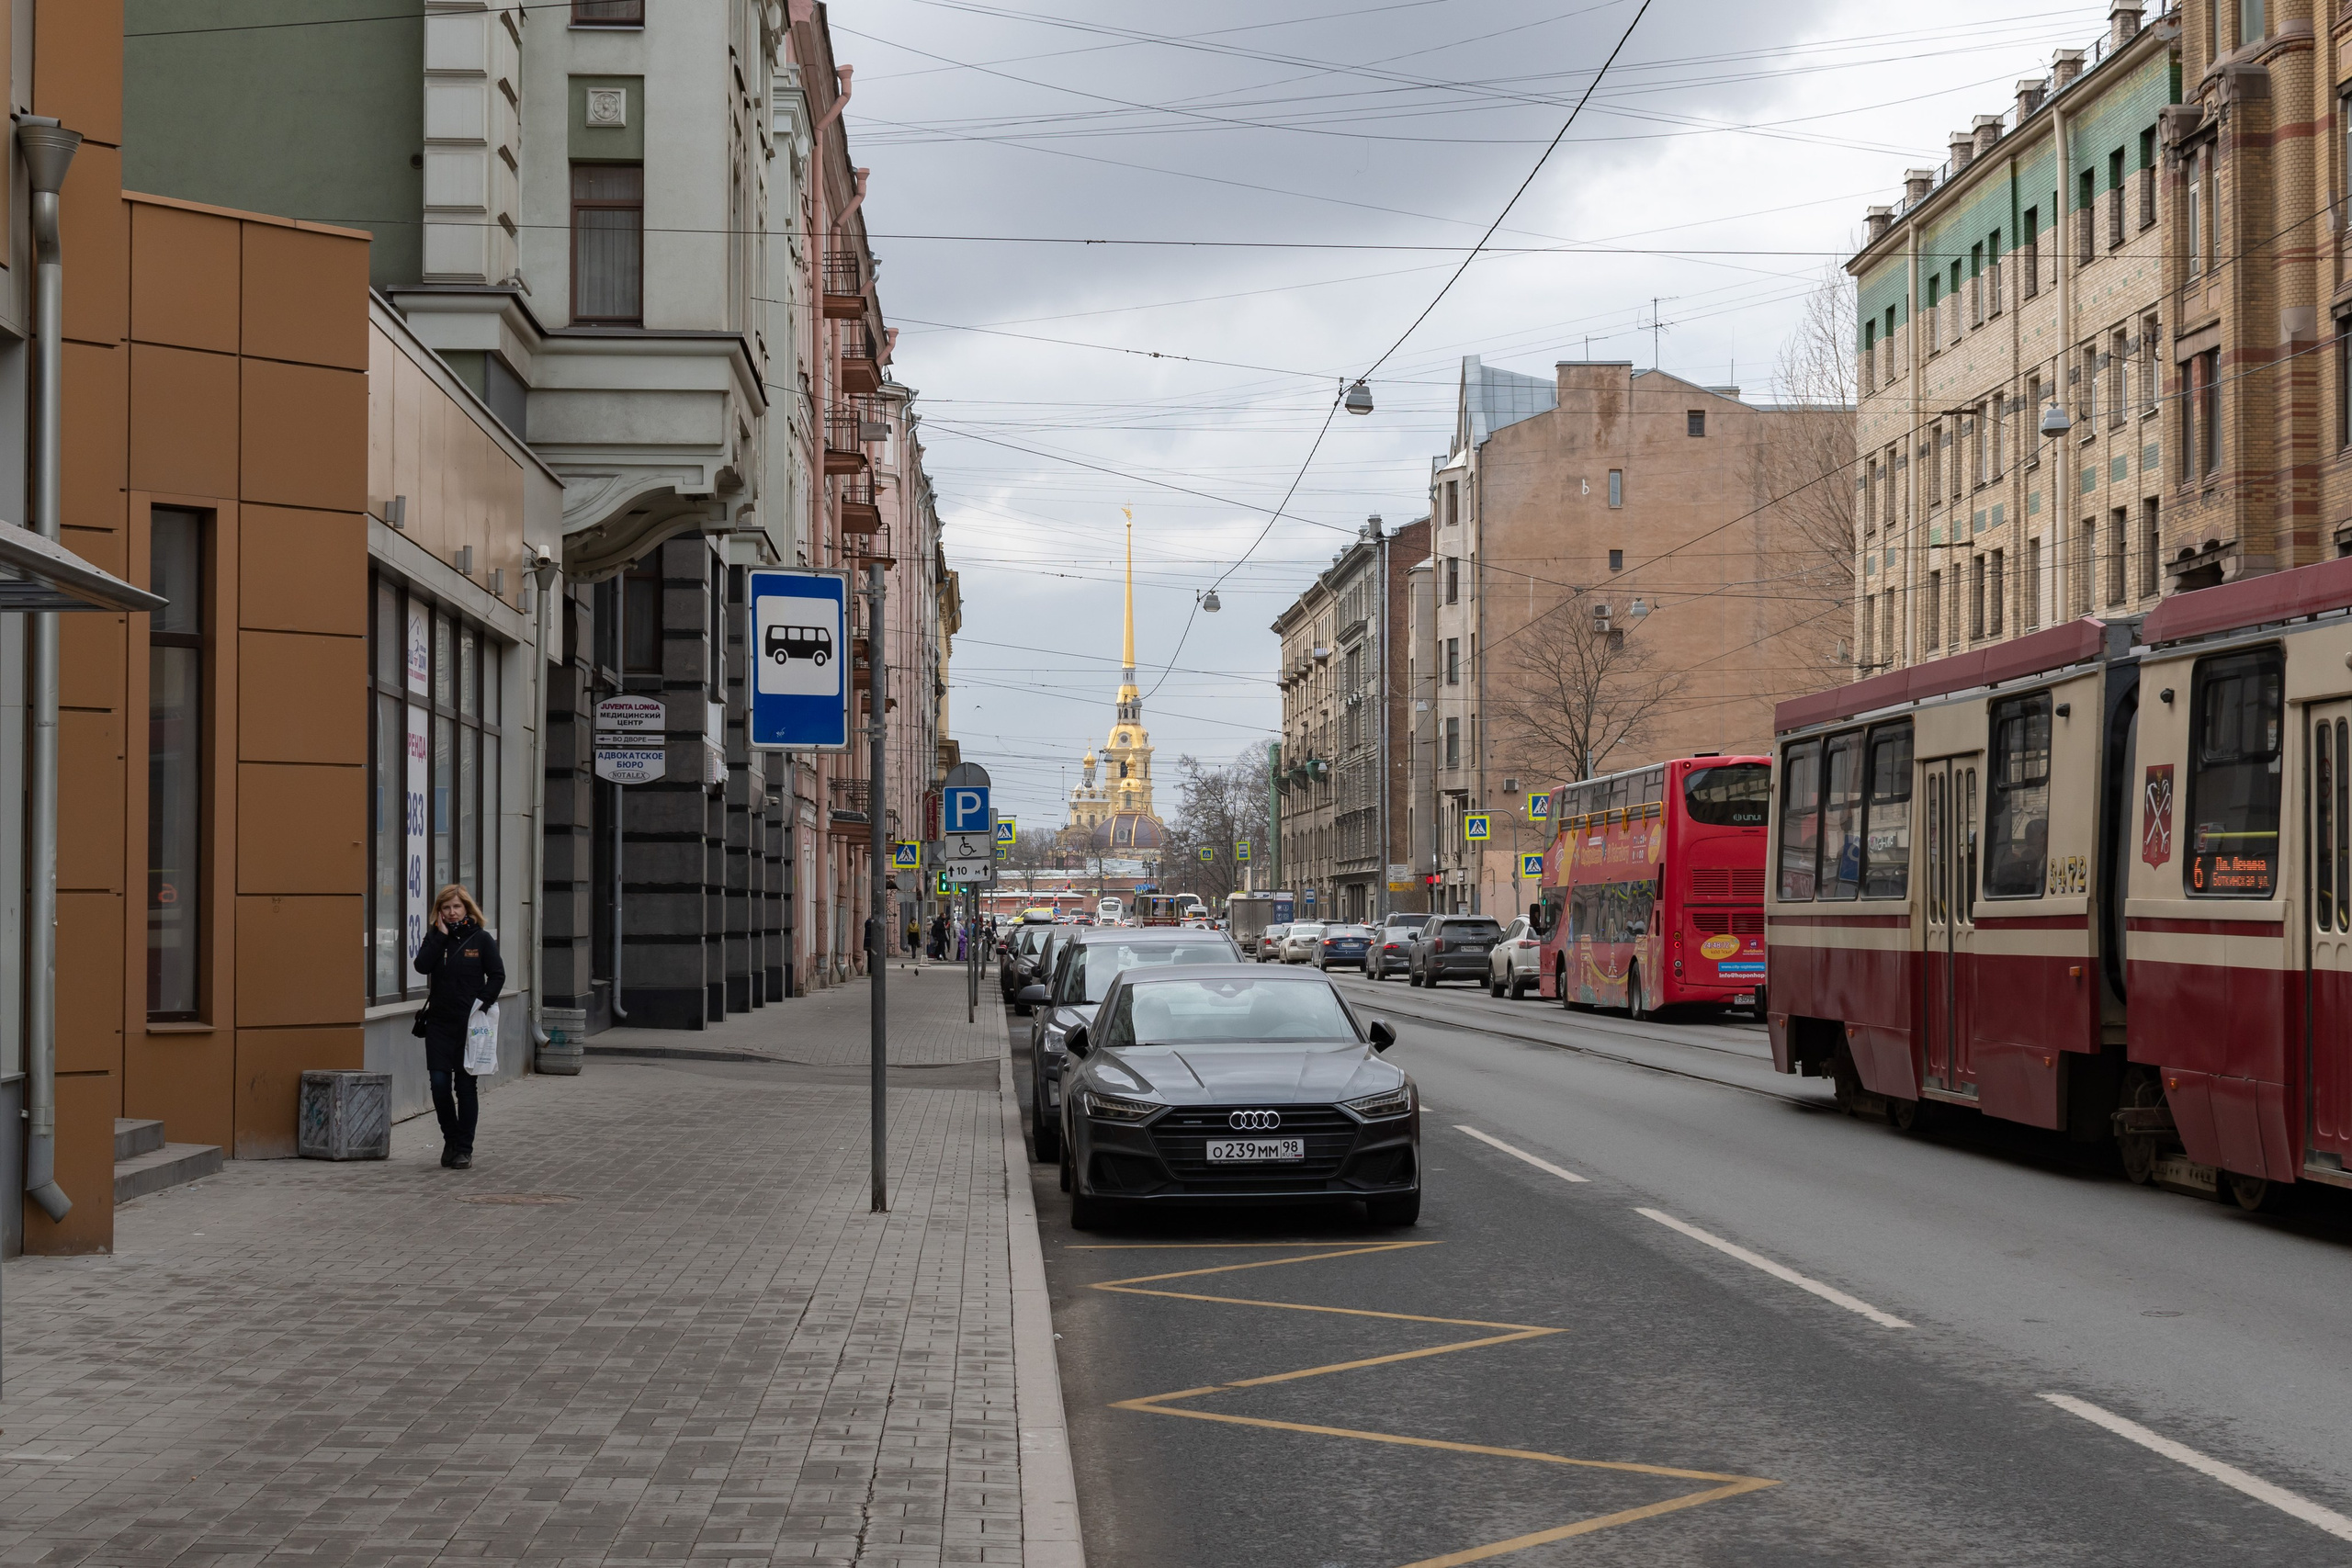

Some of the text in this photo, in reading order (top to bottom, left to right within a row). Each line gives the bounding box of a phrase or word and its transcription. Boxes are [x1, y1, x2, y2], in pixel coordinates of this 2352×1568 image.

[956, 792, 981, 828] P
[409, 854, 421, 898] 48
[956, 866, 967, 875] 10
[2050, 855, 2086, 895] 3472
[2194, 857, 2203, 888] 6
[2233, 856, 2267, 871] Ленина
[409, 914, 421, 958] 33
[1283, 1141, 1298, 1153] 98
